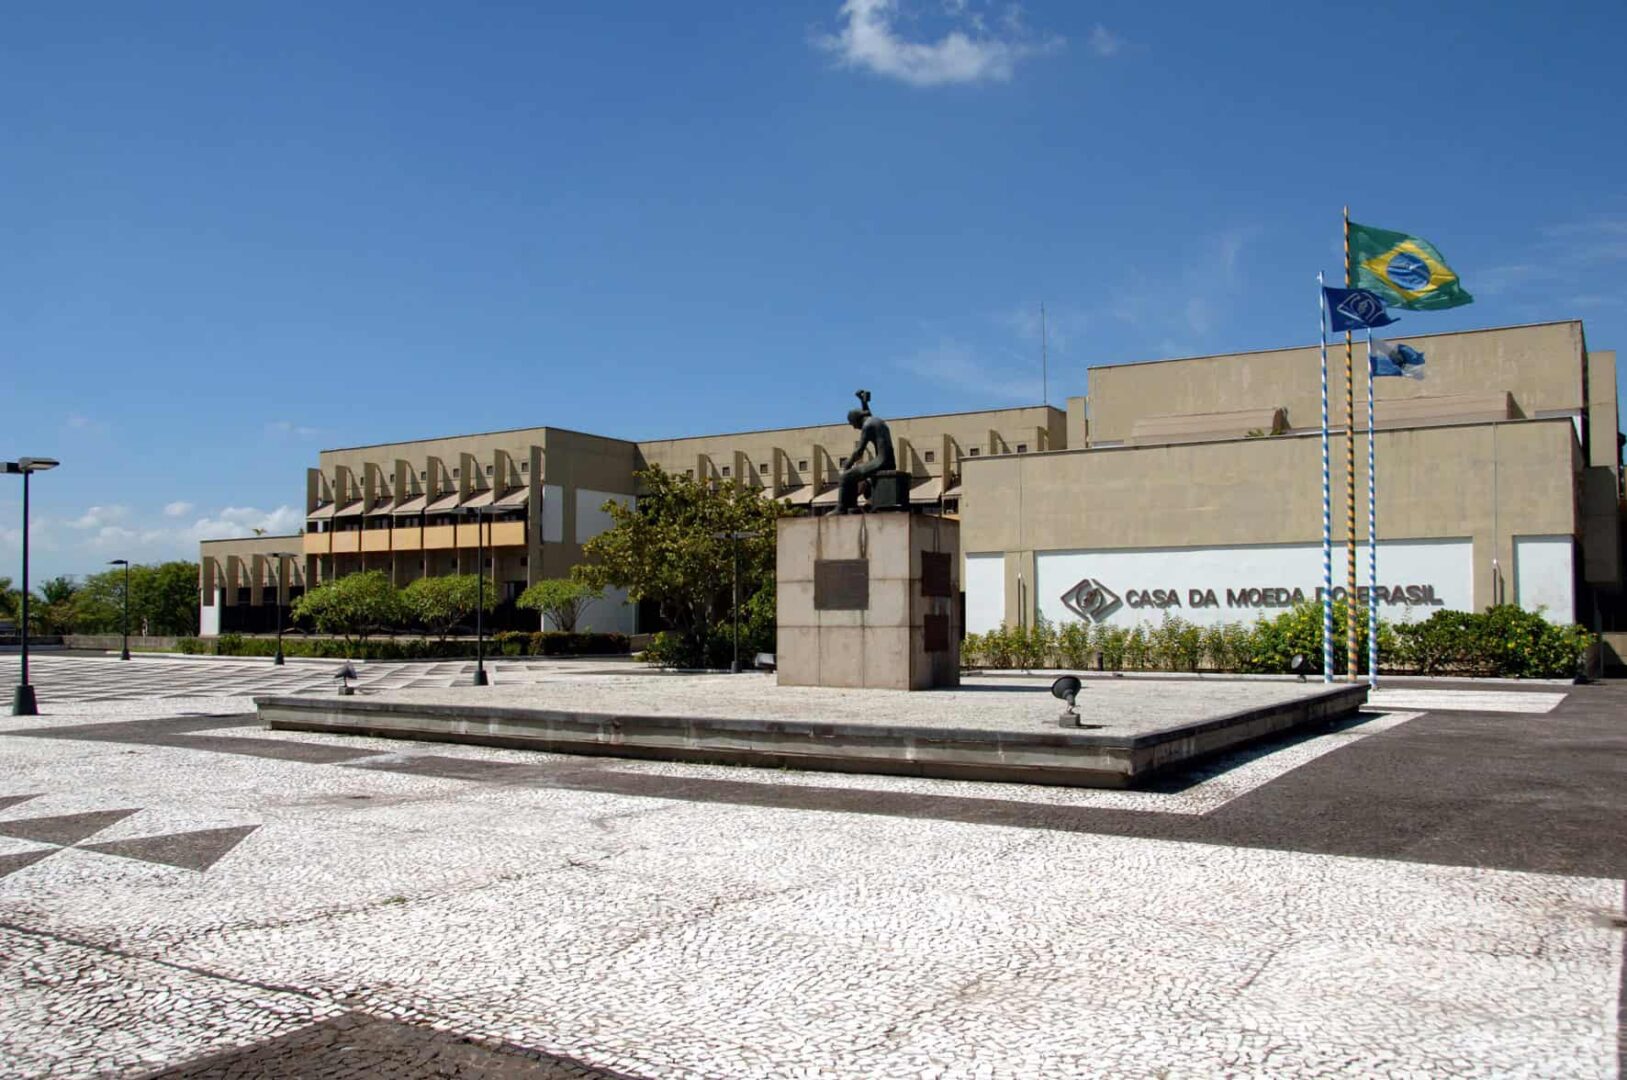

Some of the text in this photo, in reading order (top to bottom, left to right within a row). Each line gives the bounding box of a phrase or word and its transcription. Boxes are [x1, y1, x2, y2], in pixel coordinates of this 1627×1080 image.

[1125, 588, 1182, 609] CASA
[1188, 588, 1219, 608] DA
[1226, 587, 1305, 608] MOEDA
[1357, 584, 1444, 606] BRASIL
